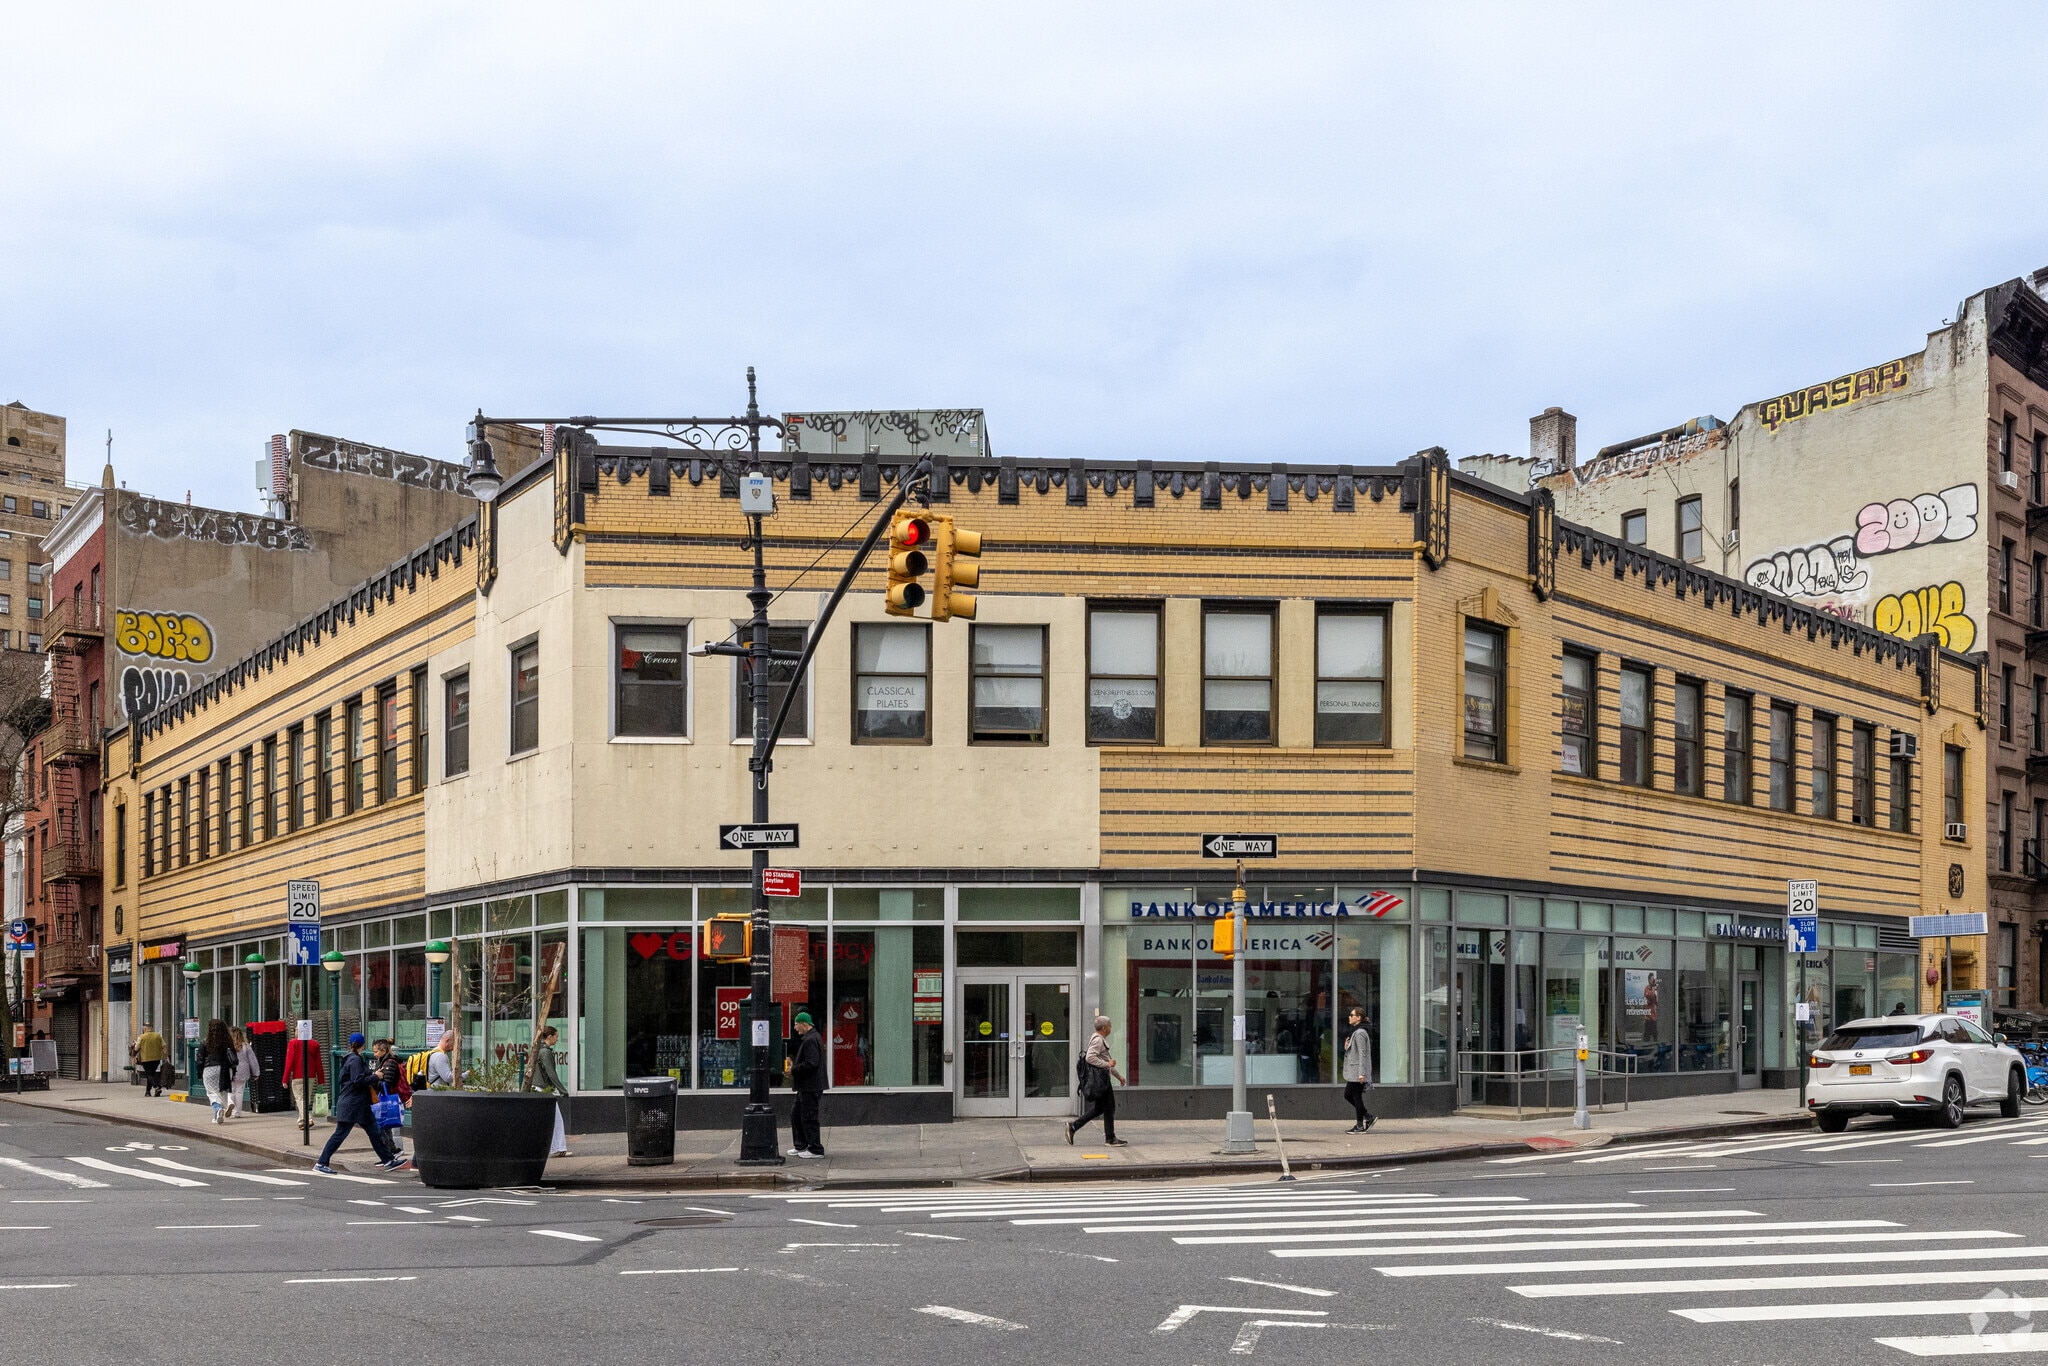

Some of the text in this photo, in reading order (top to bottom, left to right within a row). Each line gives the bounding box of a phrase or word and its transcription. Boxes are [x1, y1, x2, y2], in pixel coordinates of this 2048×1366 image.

[1759, 360, 1909, 433] QUASAR
[642, 652, 679, 664] Crown
[867, 686, 916, 696] CLASSICAL
[876, 699, 909, 708] PILATES
[731, 831, 789, 843] ONE WAY
[1213, 841, 1268, 851] ONE WAY
[291, 884, 317, 892] SPEED
[293, 892, 315, 900] LIMIT
[292, 902, 317, 917] 20
[1131, 901, 1349, 918] BANK OF AMERICA
[1792, 898, 1814, 912] 20
[1716, 923, 1787, 941] BANK OF AMERI
[1143, 938, 1302, 950] BANK O ERICA
[1598, 950, 1635, 961] AMRICA
[1796, 959, 1823, 969] AERICA
[720, 1001, 740, 1013] op
[720, 1016, 736, 1029] 24
